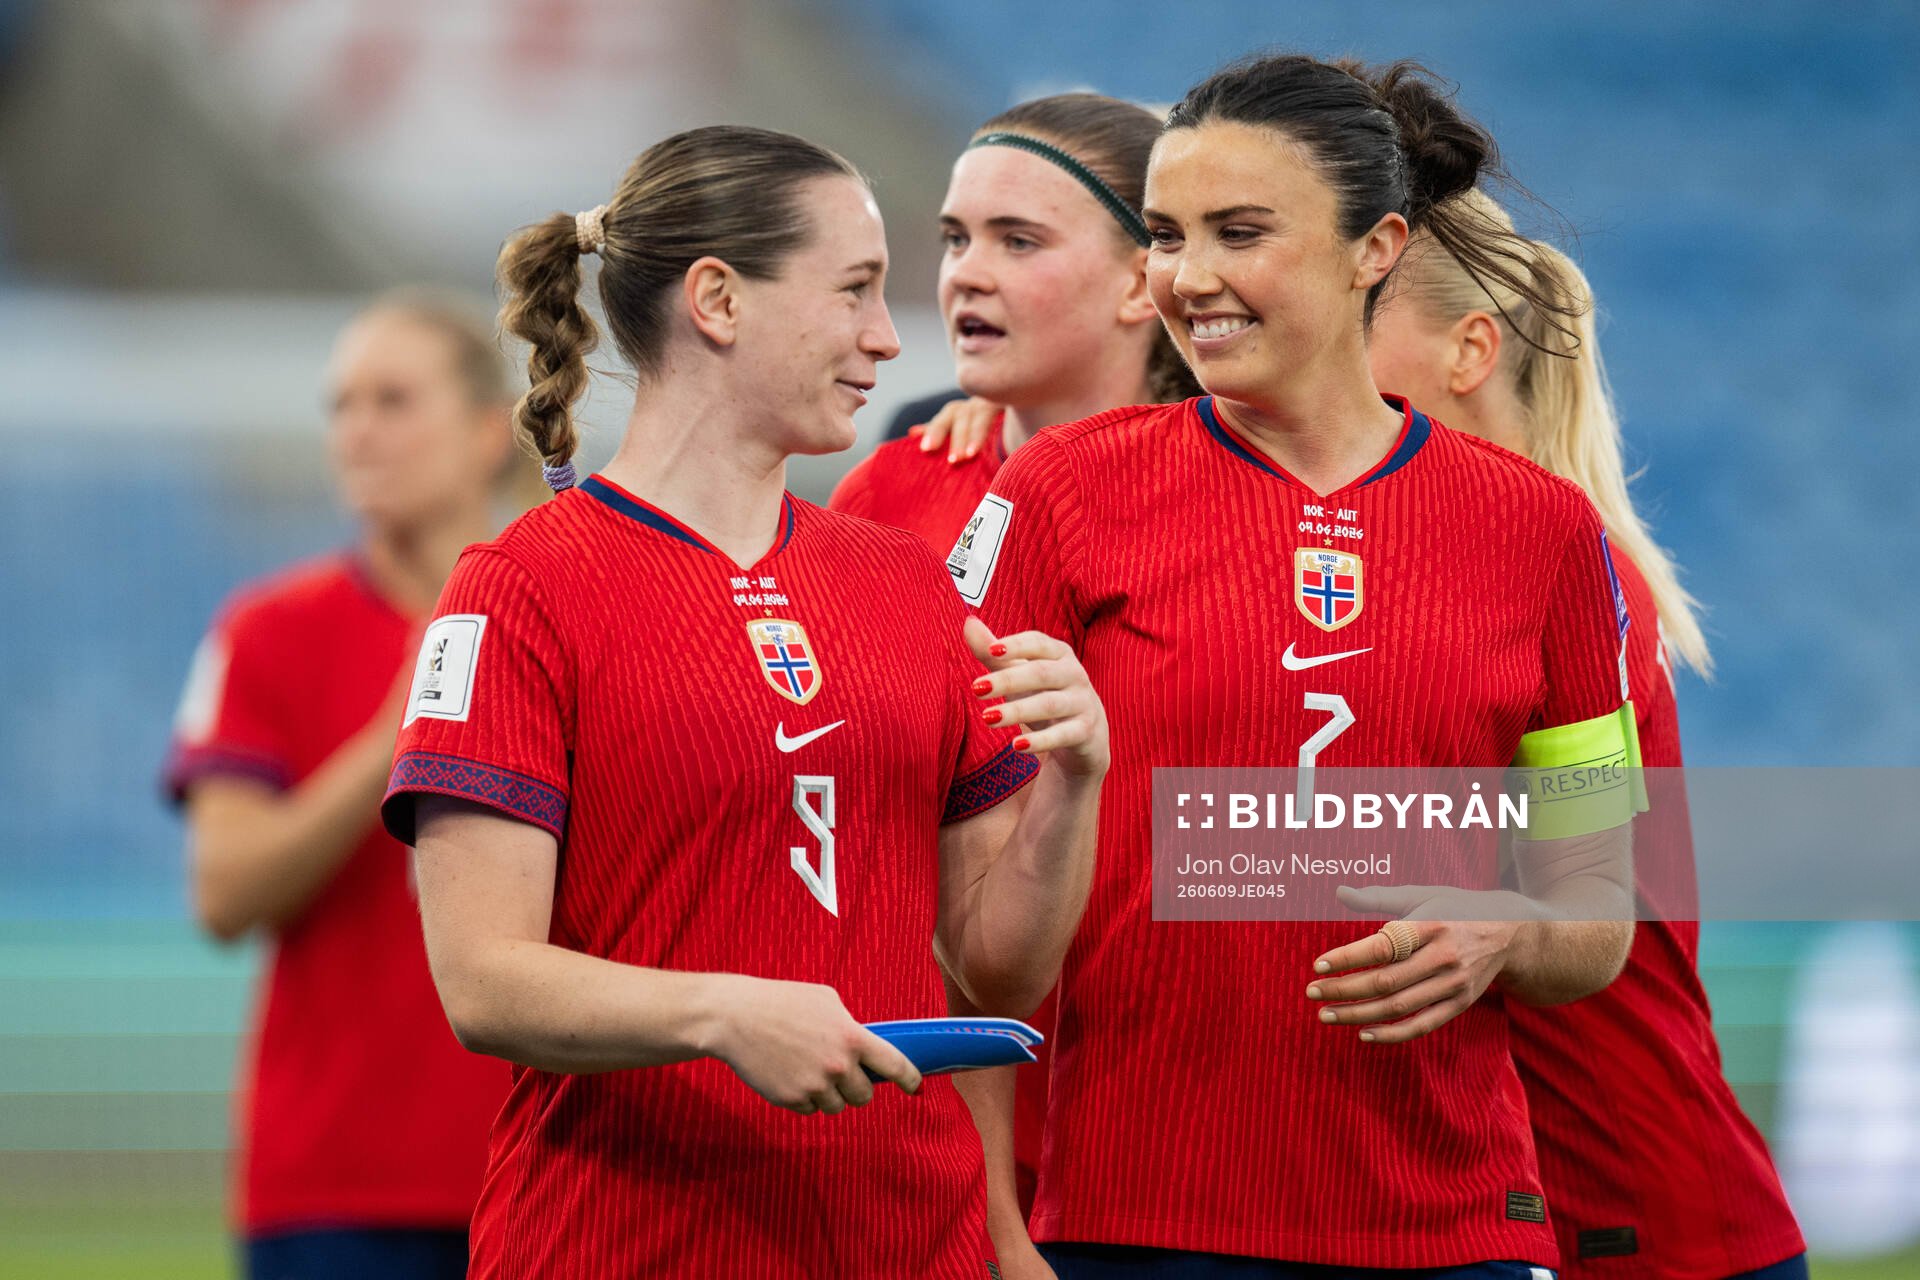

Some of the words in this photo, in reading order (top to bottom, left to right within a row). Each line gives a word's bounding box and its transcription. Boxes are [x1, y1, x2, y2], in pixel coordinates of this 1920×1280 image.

[1303, 505, 1324, 517] NOR
[1337, 508, 1357, 522] AUT
[1318, 554, 1338, 563] NORGE
[1295, 692, 1356, 832] 7
[1540, 757, 1626, 795] RESPECT
[790, 775, 838, 918] 9
